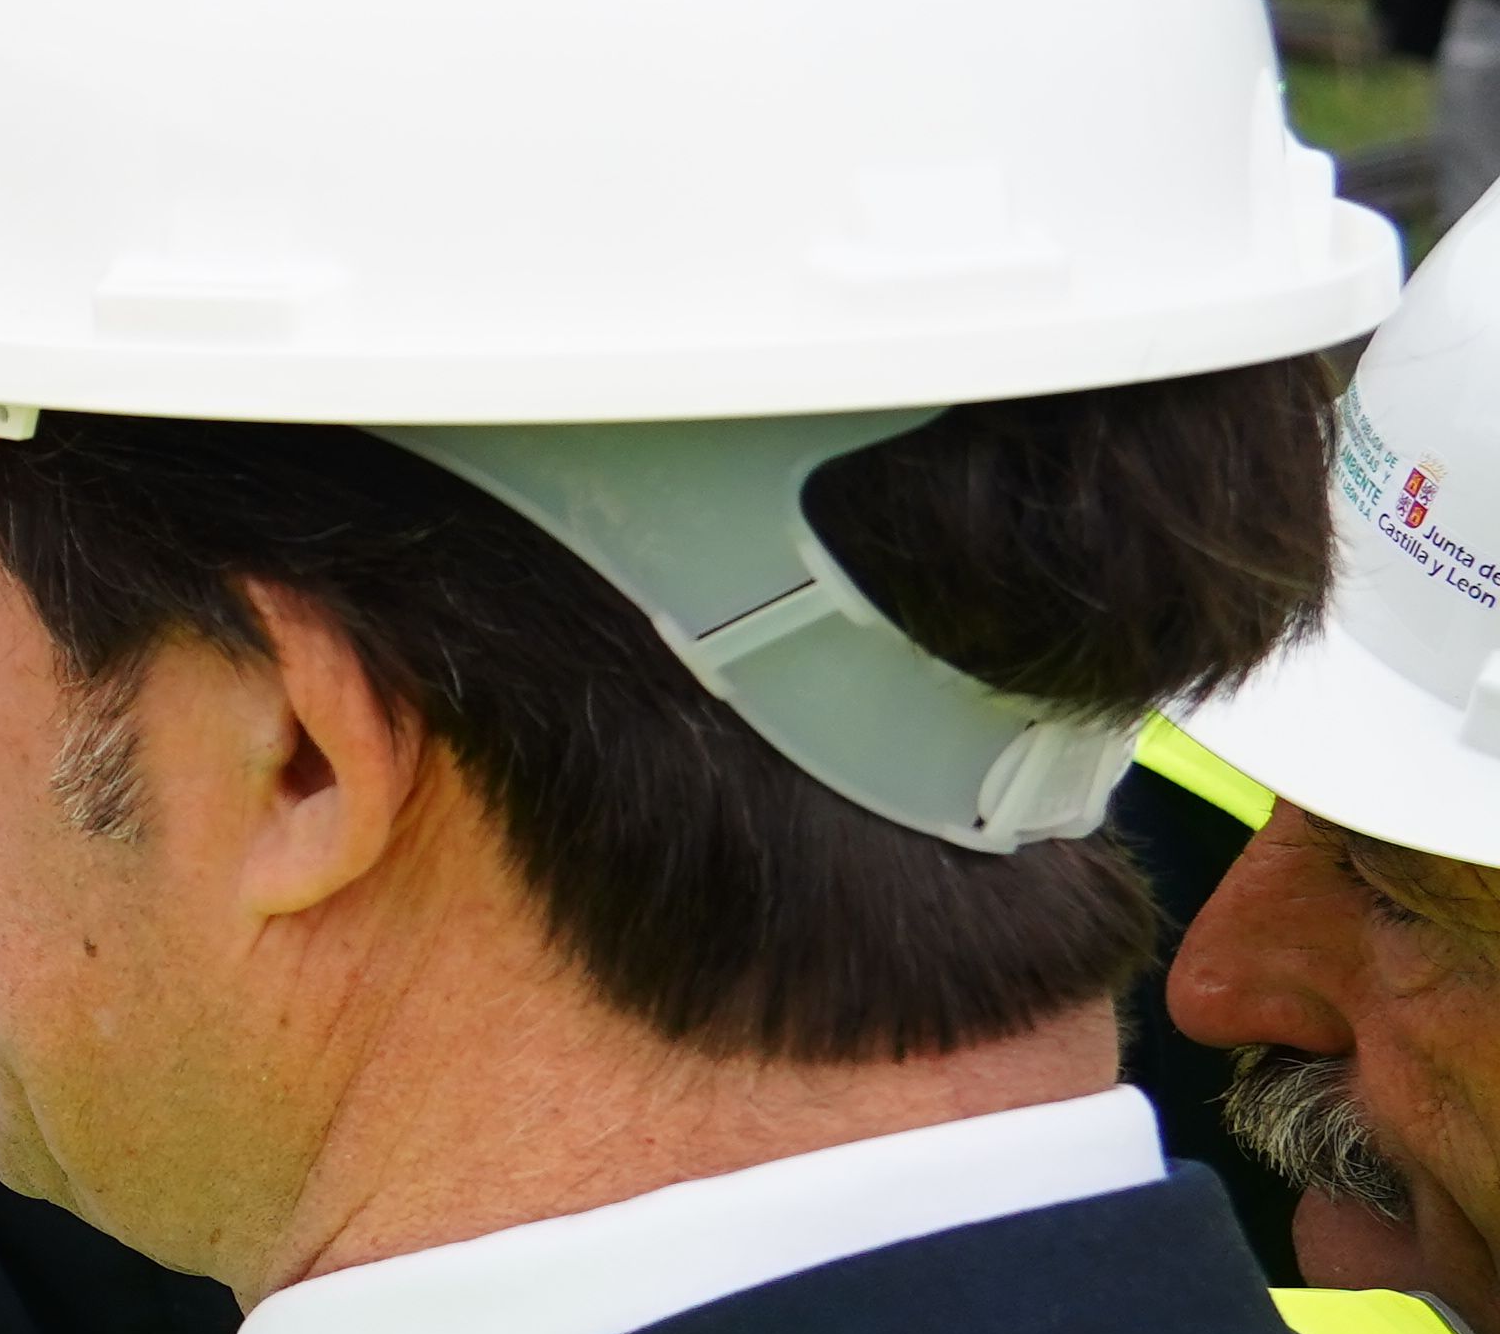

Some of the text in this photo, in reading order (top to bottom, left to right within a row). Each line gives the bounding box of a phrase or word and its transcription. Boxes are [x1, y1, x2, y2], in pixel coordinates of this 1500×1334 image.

[1384, 451, 1398, 468] DE
[1377, 513, 1496, 609] Castilla y León
[1423, 525, 1500, 586] Junta de
